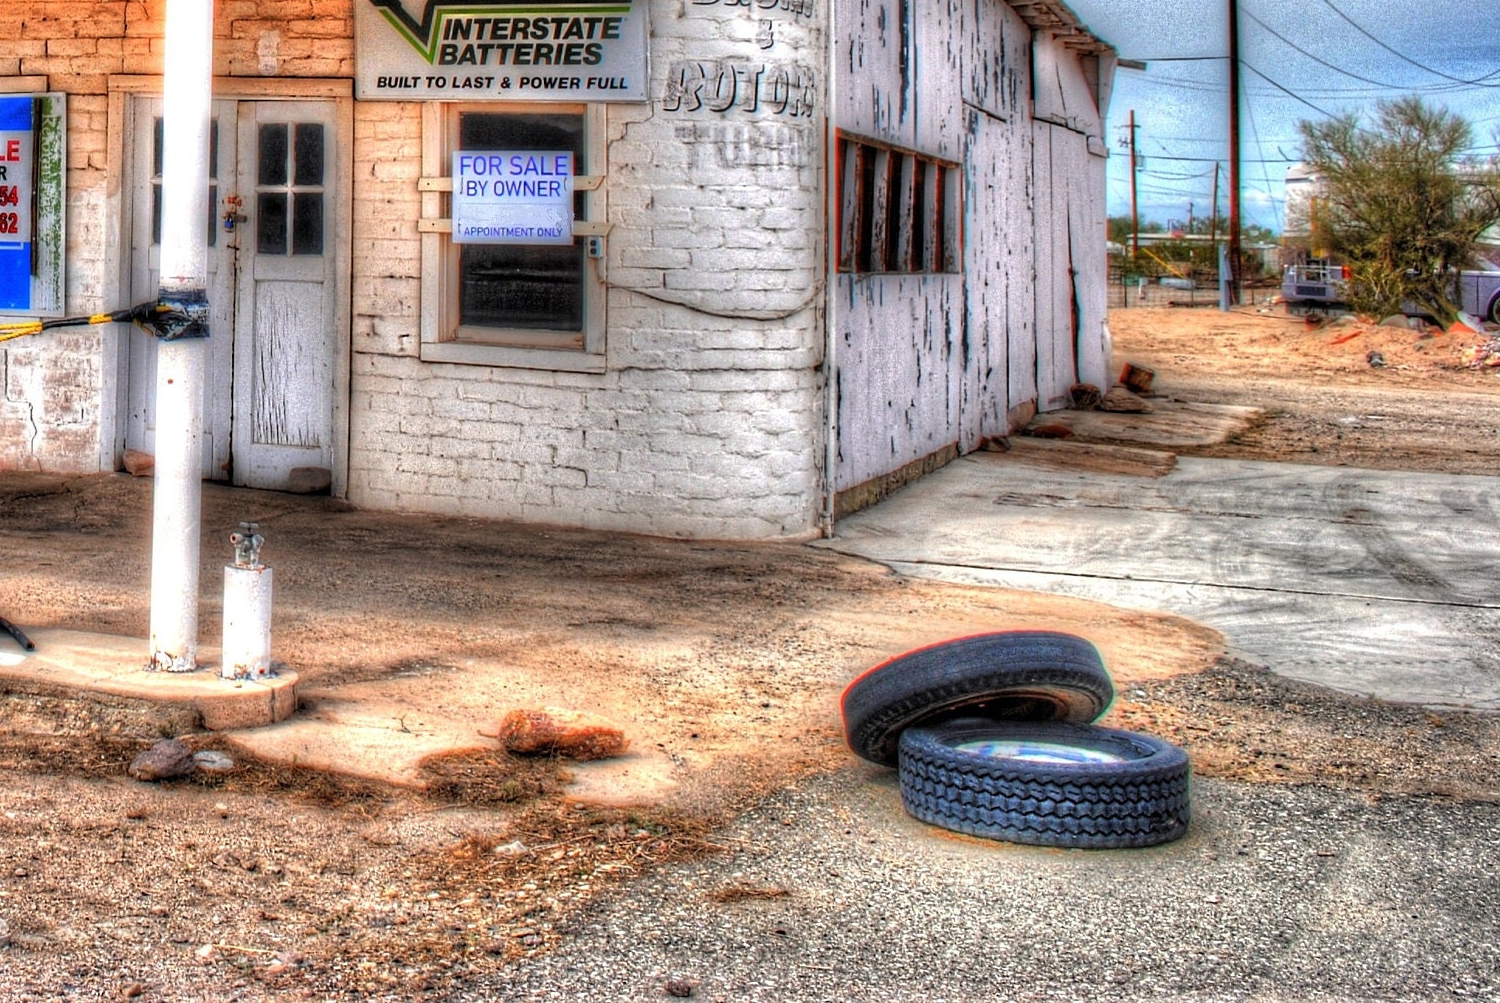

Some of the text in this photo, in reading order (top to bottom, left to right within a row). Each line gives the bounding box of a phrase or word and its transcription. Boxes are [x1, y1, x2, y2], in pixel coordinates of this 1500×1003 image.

[442, 17, 621, 41] INTERSTATE
[438, 43, 604, 66] BATTERIES
[376, 76, 628, 90] BUILT TO LAST & POWER FULL
[459, 155, 568, 176] FOR SALE
[466, 180, 561, 197] BY OWNER
[463, 226, 563, 237] APPOINTMENT ONLY
